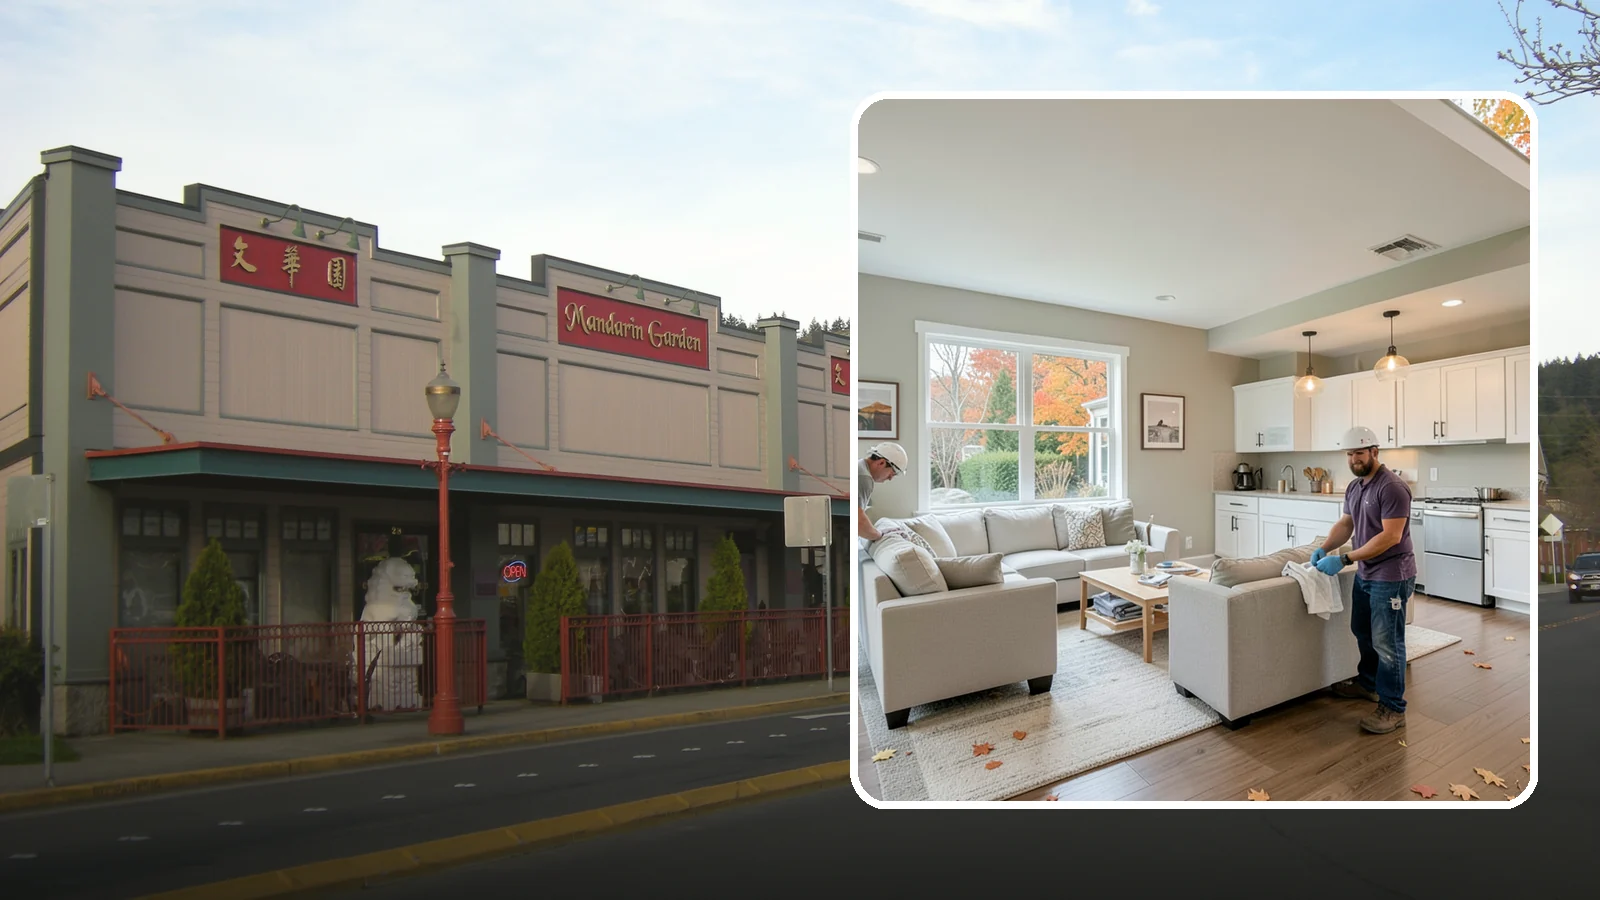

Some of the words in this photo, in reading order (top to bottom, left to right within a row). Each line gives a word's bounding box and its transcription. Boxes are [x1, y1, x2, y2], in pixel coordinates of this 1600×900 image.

[231, 236, 346, 290] 文華園
[565, 302, 644, 341] Mandarin
[648, 320, 701, 352] Garden
[503, 565, 527, 578] OPEN
